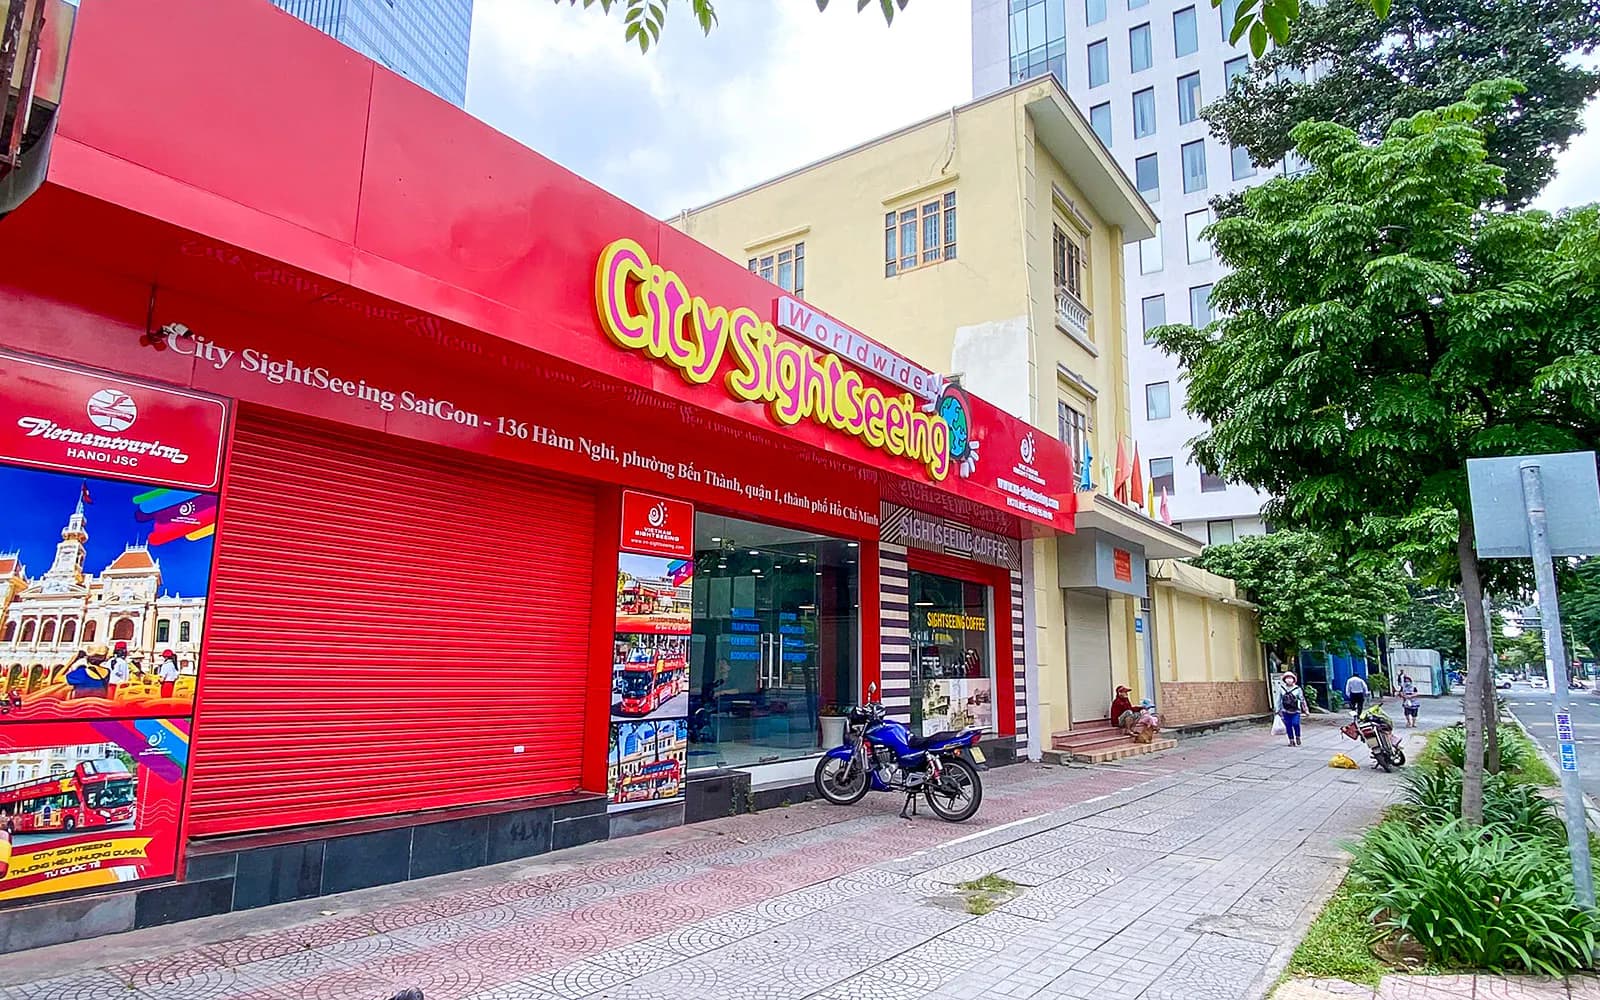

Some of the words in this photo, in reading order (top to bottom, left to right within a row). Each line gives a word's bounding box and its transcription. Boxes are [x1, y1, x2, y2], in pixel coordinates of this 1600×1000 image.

[597, 239, 728, 383] City
[726, 308, 949, 480] Sightseeing
[789, 302, 923, 391] Worldwide
[17, 416, 188, 464] Vietnamtourism
[167, 331, 235, 370] City
[240, 348, 396, 412] SightSeeing
[399, 390, 479, 428] SaiGon
[496, 416, 528, 440] 136
[531, 424, 574, 451] Hàm
[578, 436, 620, 464] Nghi,
[622, 450, 676, 480] phường
[677, 462, 701, 483] Bến
[703, 469, 744, 495] Thành,
[745, 484, 772, 501] quận
[783, 491, 810, 509] thành
[857, 509, 880, 527] Minh
[67, 448, 110, 463] HANOI
[112, 455, 138, 467] JSC
[900, 515, 973, 552] SIGHTSEEING
[974, 535, 1009, 560] COFFEE
[927, 612, 966, 630] SIGHTSEEING
[965, 616, 986, 631] COFFEE
